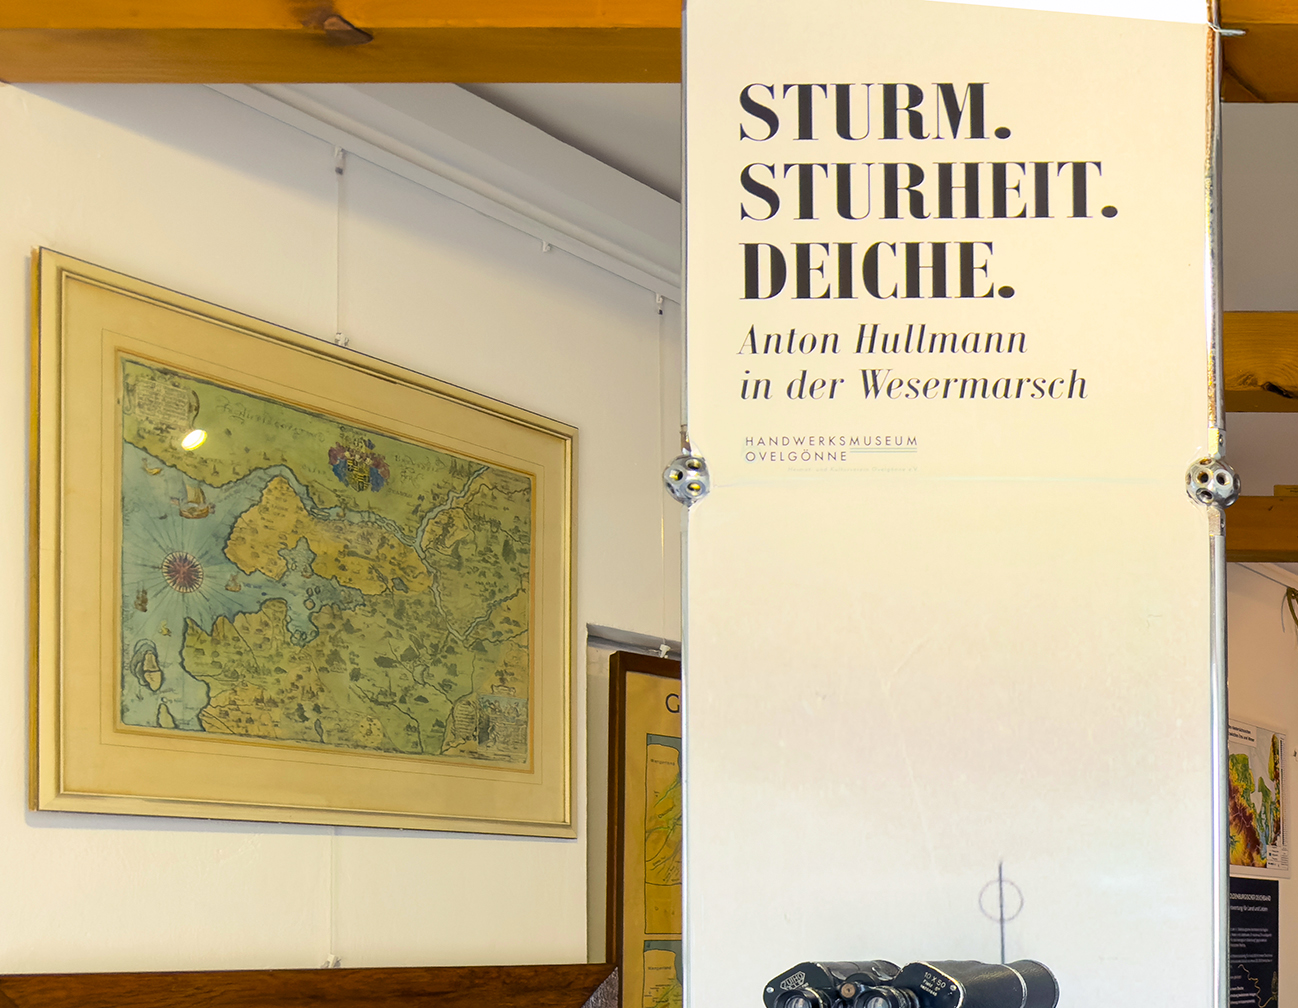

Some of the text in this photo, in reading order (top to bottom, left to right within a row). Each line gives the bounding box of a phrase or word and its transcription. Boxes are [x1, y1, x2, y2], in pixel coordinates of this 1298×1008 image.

[739, 82, 1012, 141] STURM.
[739, 161, 1118, 221] STURHEIT.
[739, 241, 1015, 300] DEICHE.
[737, 323, 1028, 355] Anton Hullmann
[740, 369, 1089, 400] in der Wesermarsch
[745, 436, 918, 446] HANDWERKSMUSEUM
[745, 449, 847, 462] OVELGÖNNE
